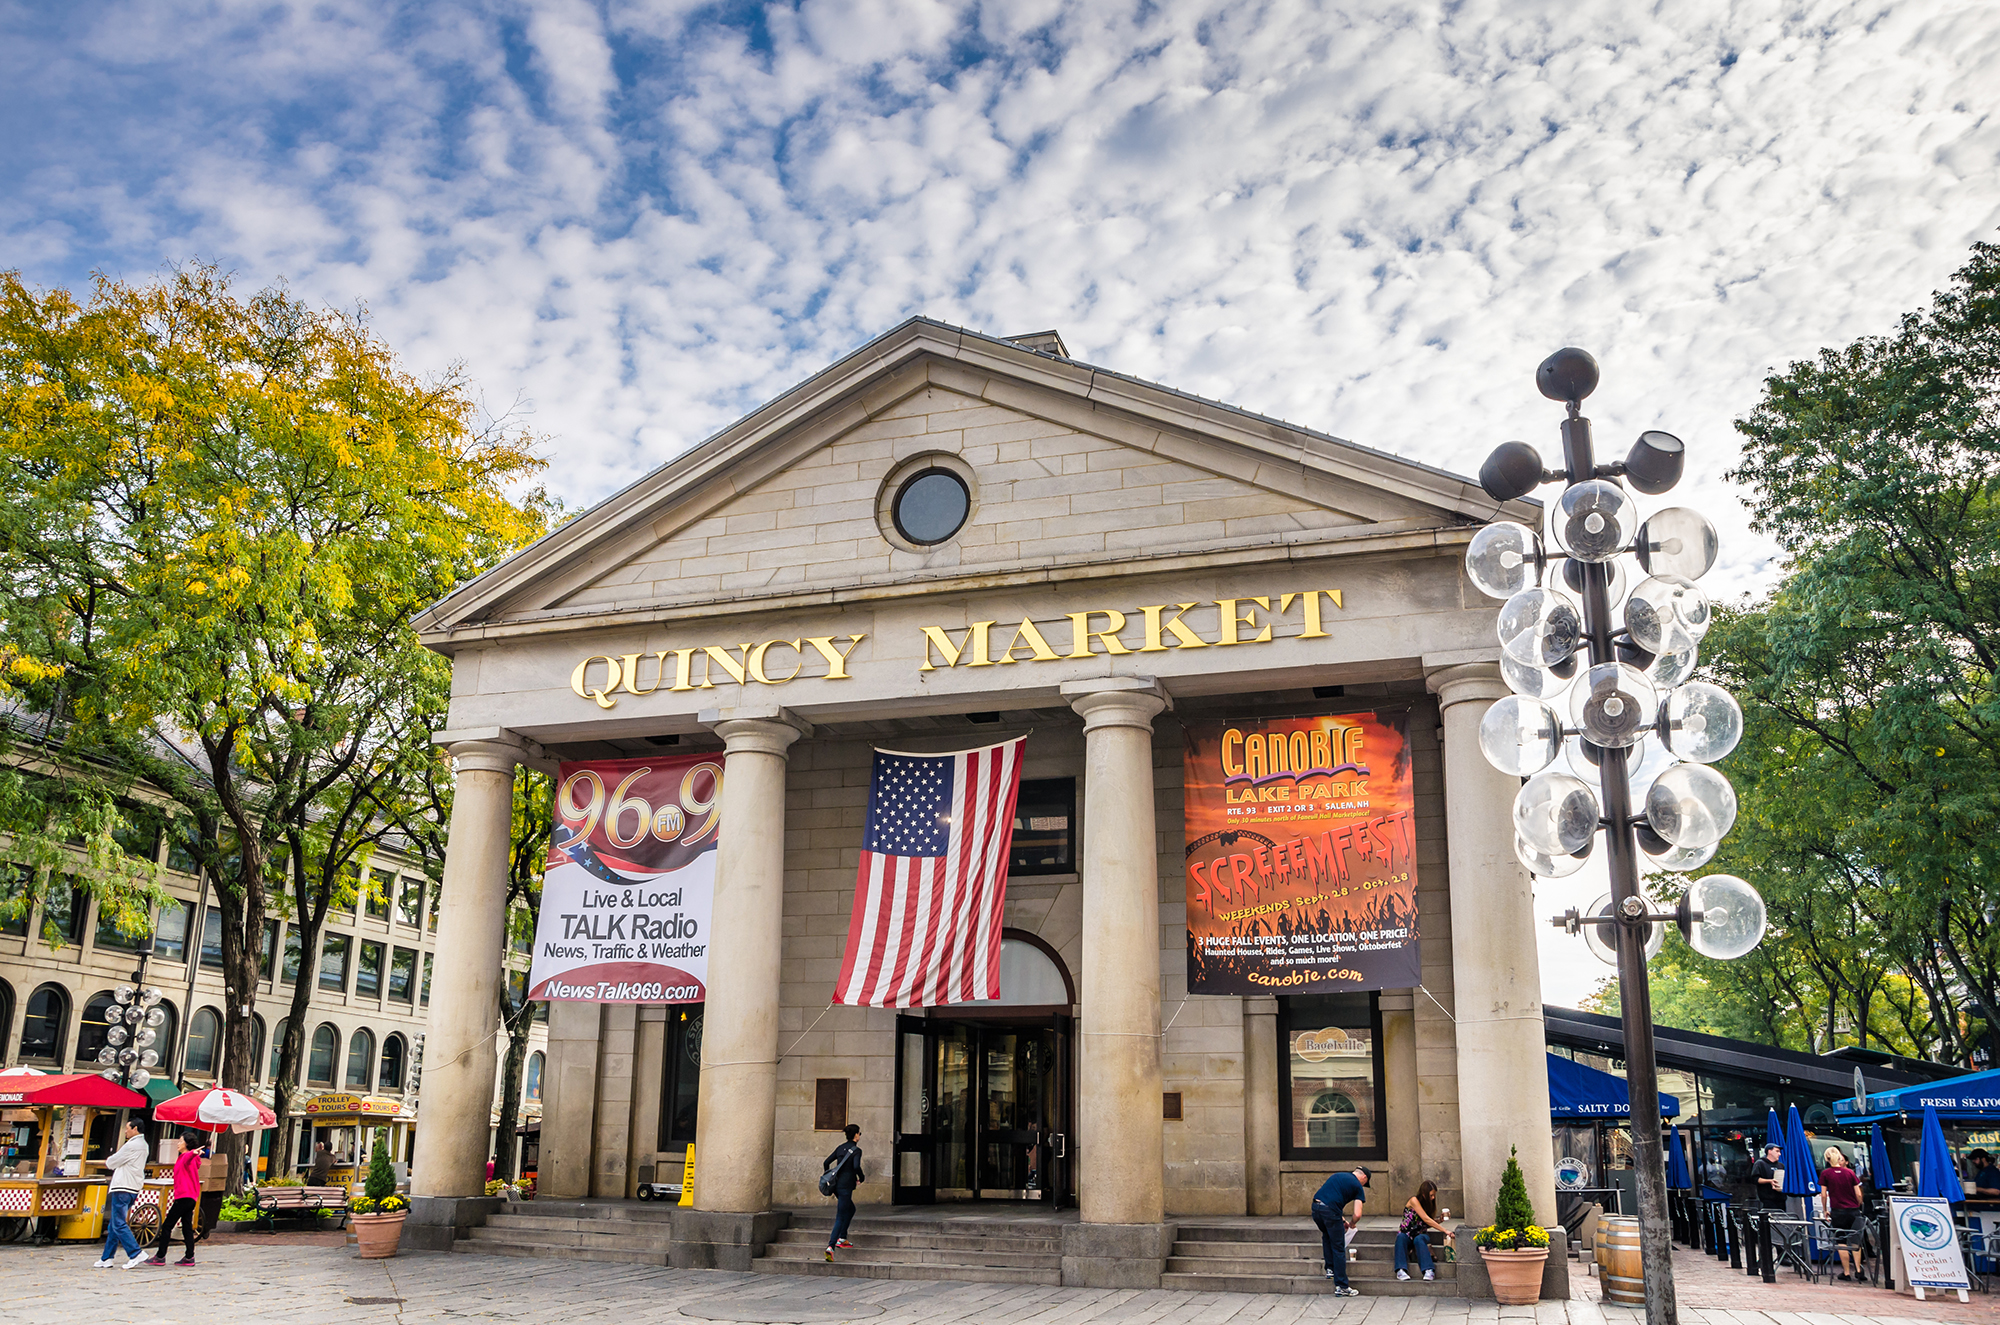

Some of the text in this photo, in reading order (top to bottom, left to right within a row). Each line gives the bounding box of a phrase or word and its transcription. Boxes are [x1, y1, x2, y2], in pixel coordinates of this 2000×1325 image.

[570, 589, 1342, 709] QUINCY MARKET
[1221, 727, 1367, 780] CANOBIE
[1225, 780, 1369, 804] LAKE PARK
[1227, 807, 1244, 816] RTE.
[1246, 806, 1257, 815] 93
[1267, 805, 1285, 813] EXIT
[1286, 805, 1292, 813] 2
[1294, 804, 1306, 812] OR
[1309, 804, 1314, 812] 3
[657, 813, 682, 833] FM
[1227, 817, 1240, 826] Only
[1250, 816, 1272, 824] minutes
[1274, 815, 1289, 823] north
[1290, 814, 1297, 822] of
[1298, 813, 1319, 822] Faneuil
[1319, 812, 1331, 820] Hall
[582, 887, 682, 909] Live & Local
[1296, 893, 1330, 908] Sept.
[1332, 887, 1349, 899] 28
[1363, 879, 1389, 892] Oct.
[1392, 873, 1409, 884] 28
[560, 912, 698, 940] TALK Radio
[1198, 928, 1408, 946] 3 HUGE FALL EVENTS, ONE LOCATION, ONE PRICE!
[544, 941, 706, 961] News, Traffic & Weather
[1205, 940, 1402, 957] Haunted Houses, Rides, Games, Live Shows, Oktoberfest
[1270, 954, 1339, 966] and so much more!
[1248, 968, 1364, 987] canobie.com
[544, 980, 699, 1000] NewsTalk969.com
[1305, 1040, 1364, 1054] Bagelville
[317, 1095, 351, 1103] TROLLEY
[1919, 1098, 1956, 1107] FRESH
[1578, 1104, 1609, 1113] SALTY
[1614, 1104, 1630, 1113] DO
[1906, 1207, 1940, 1219] SALTY DOG
[1909, 1251, 1935, 1259] We're
[1915, 1265, 1939, 1273] Fresh
